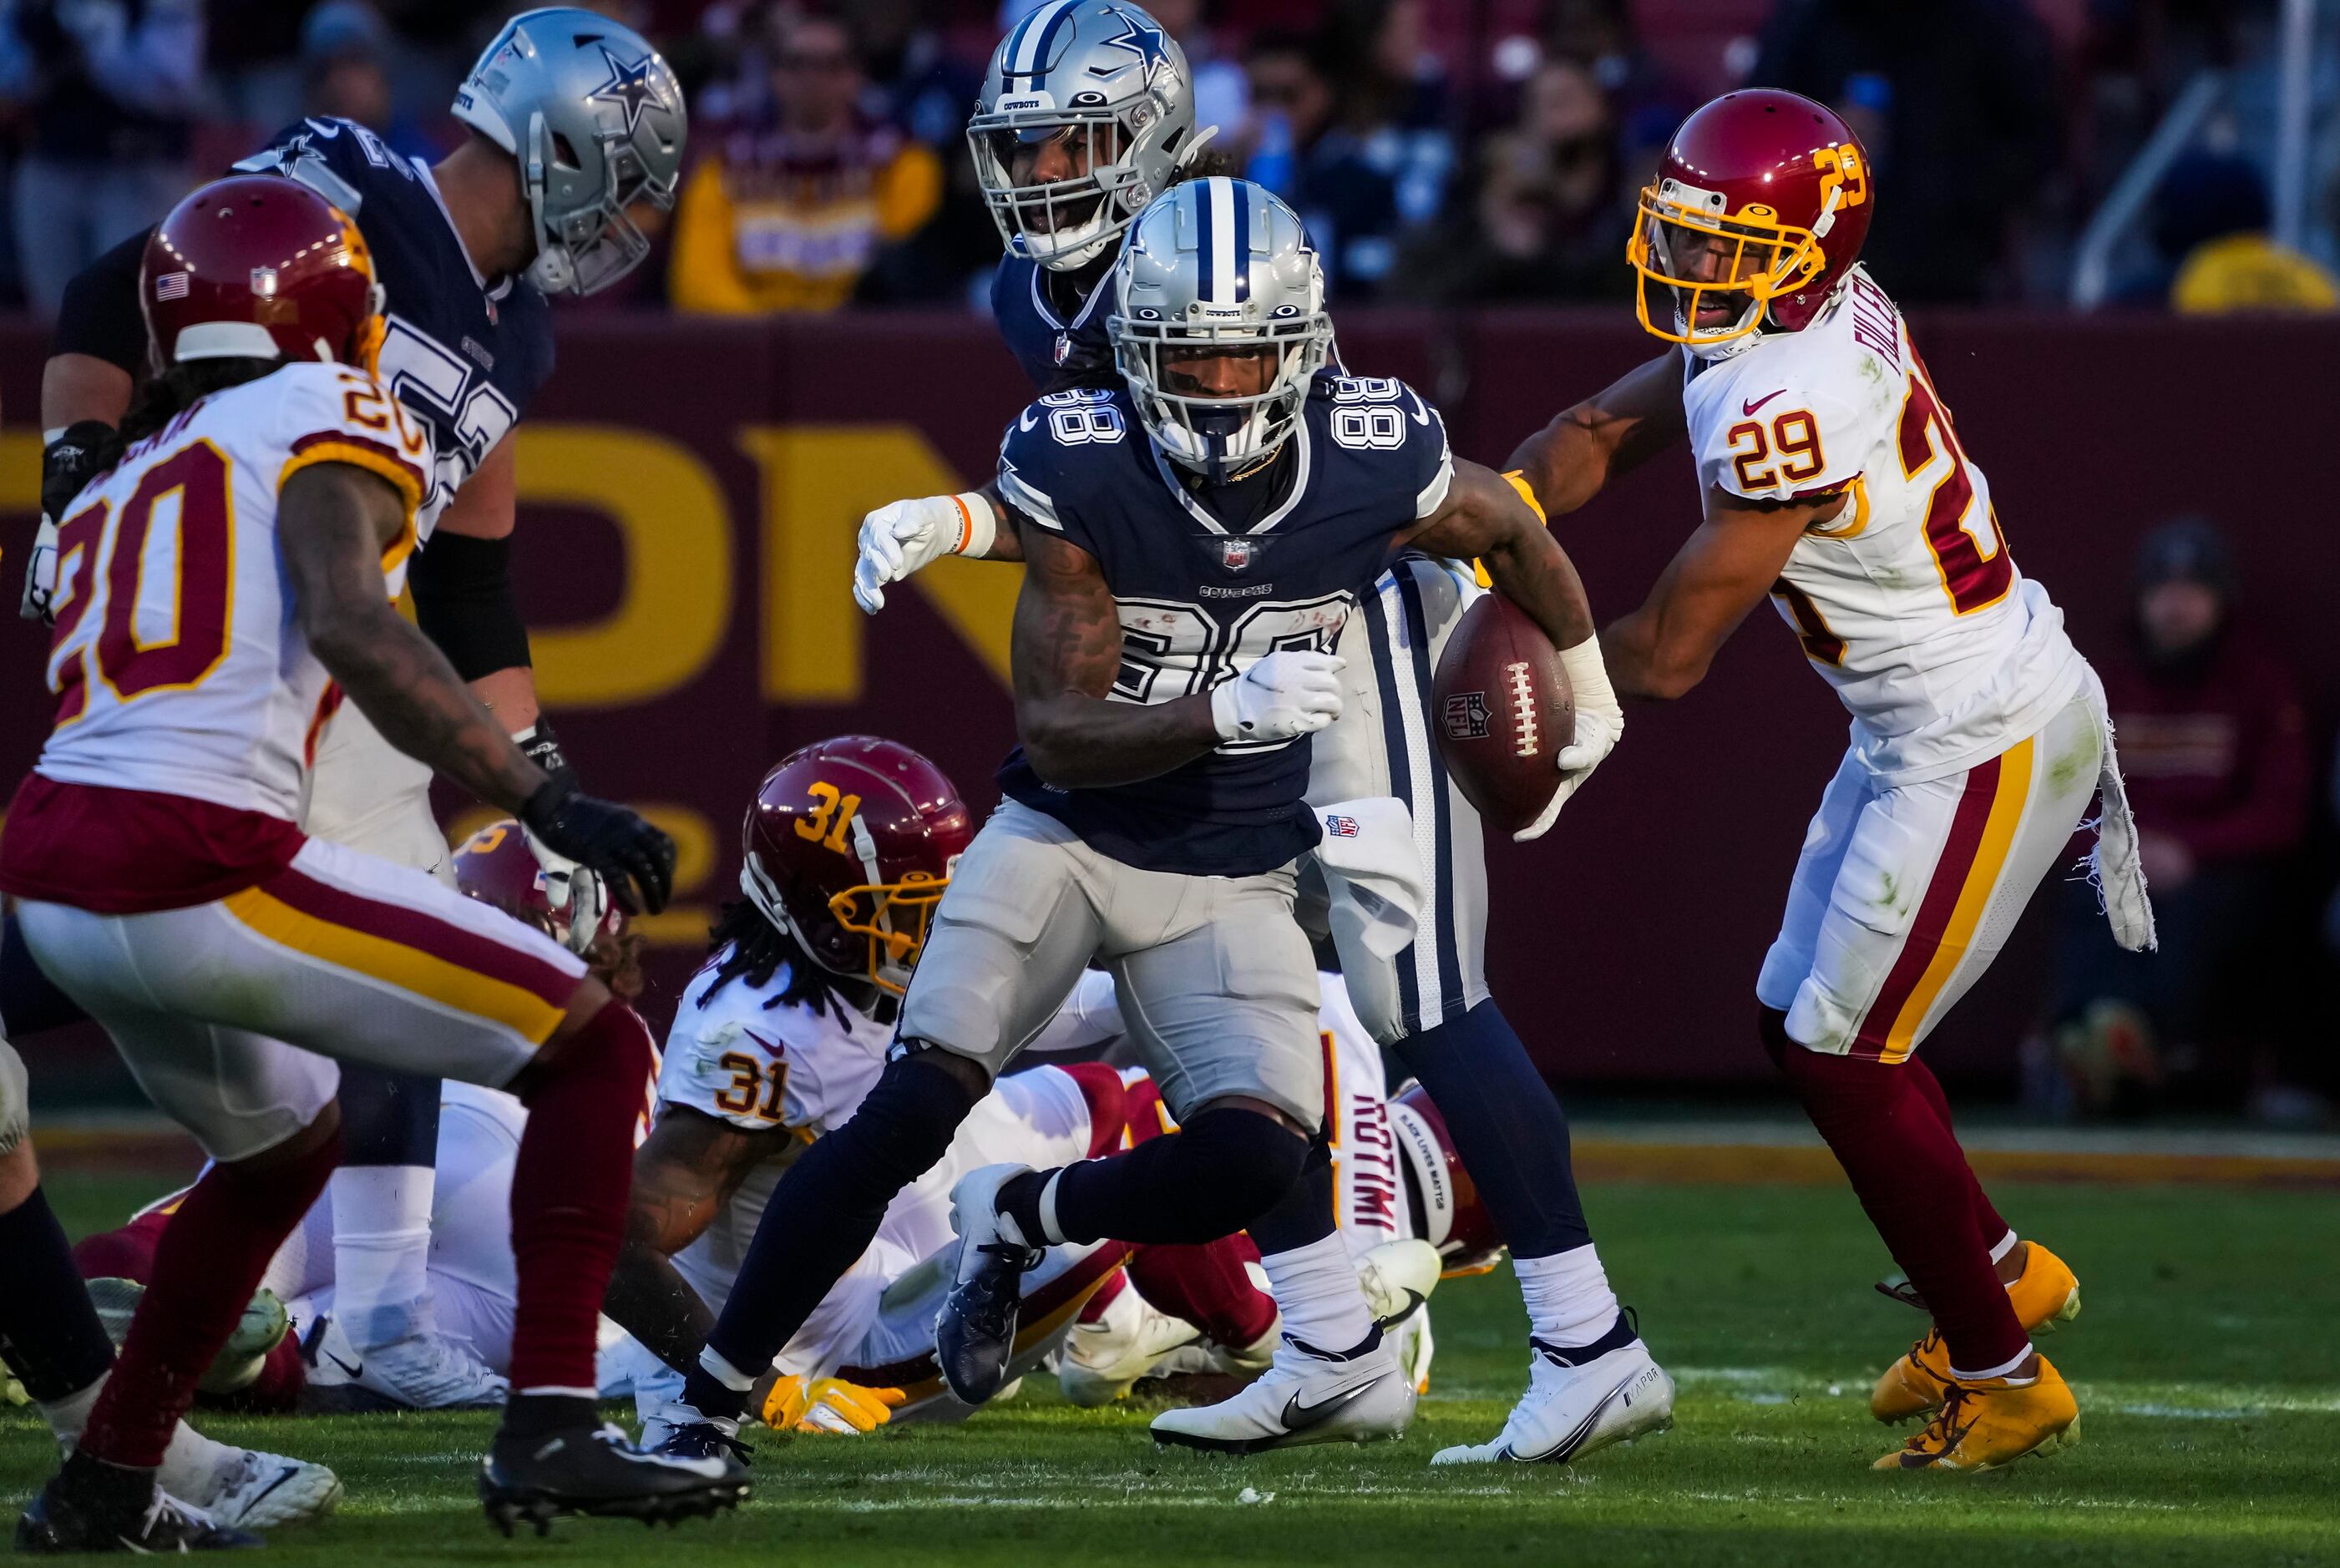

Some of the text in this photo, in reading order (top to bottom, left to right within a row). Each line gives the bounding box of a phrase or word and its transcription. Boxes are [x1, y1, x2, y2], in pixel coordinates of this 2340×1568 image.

[1004, 100, 1040, 110] COWBOYS
[1813, 143, 1866, 213] 29
[1851, 274, 1901, 377] FULLER
[337, 372, 424, 456] 20
[1038, 387, 1127, 446] 88
[1330, 376, 1406, 450] 88
[1728, 408, 1827, 493] 29
[1896, 324, 2014, 618] 2
[48, 436, 236, 736] 20
[1199, 584, 1273, 598] COWBOYS
[1447, 698, 1468, 735] NFL
[794, 781, 861, 854] 31
[1340, 818, 1356, 835] NFL
[714, 1050, 788, 1123] 31
[1353, 1094, 1396, 1233] ROTIMI
[1417, 1139, 1435, 1167] LIVES
[1629, 1368, 1659, 1398] VAPOR
